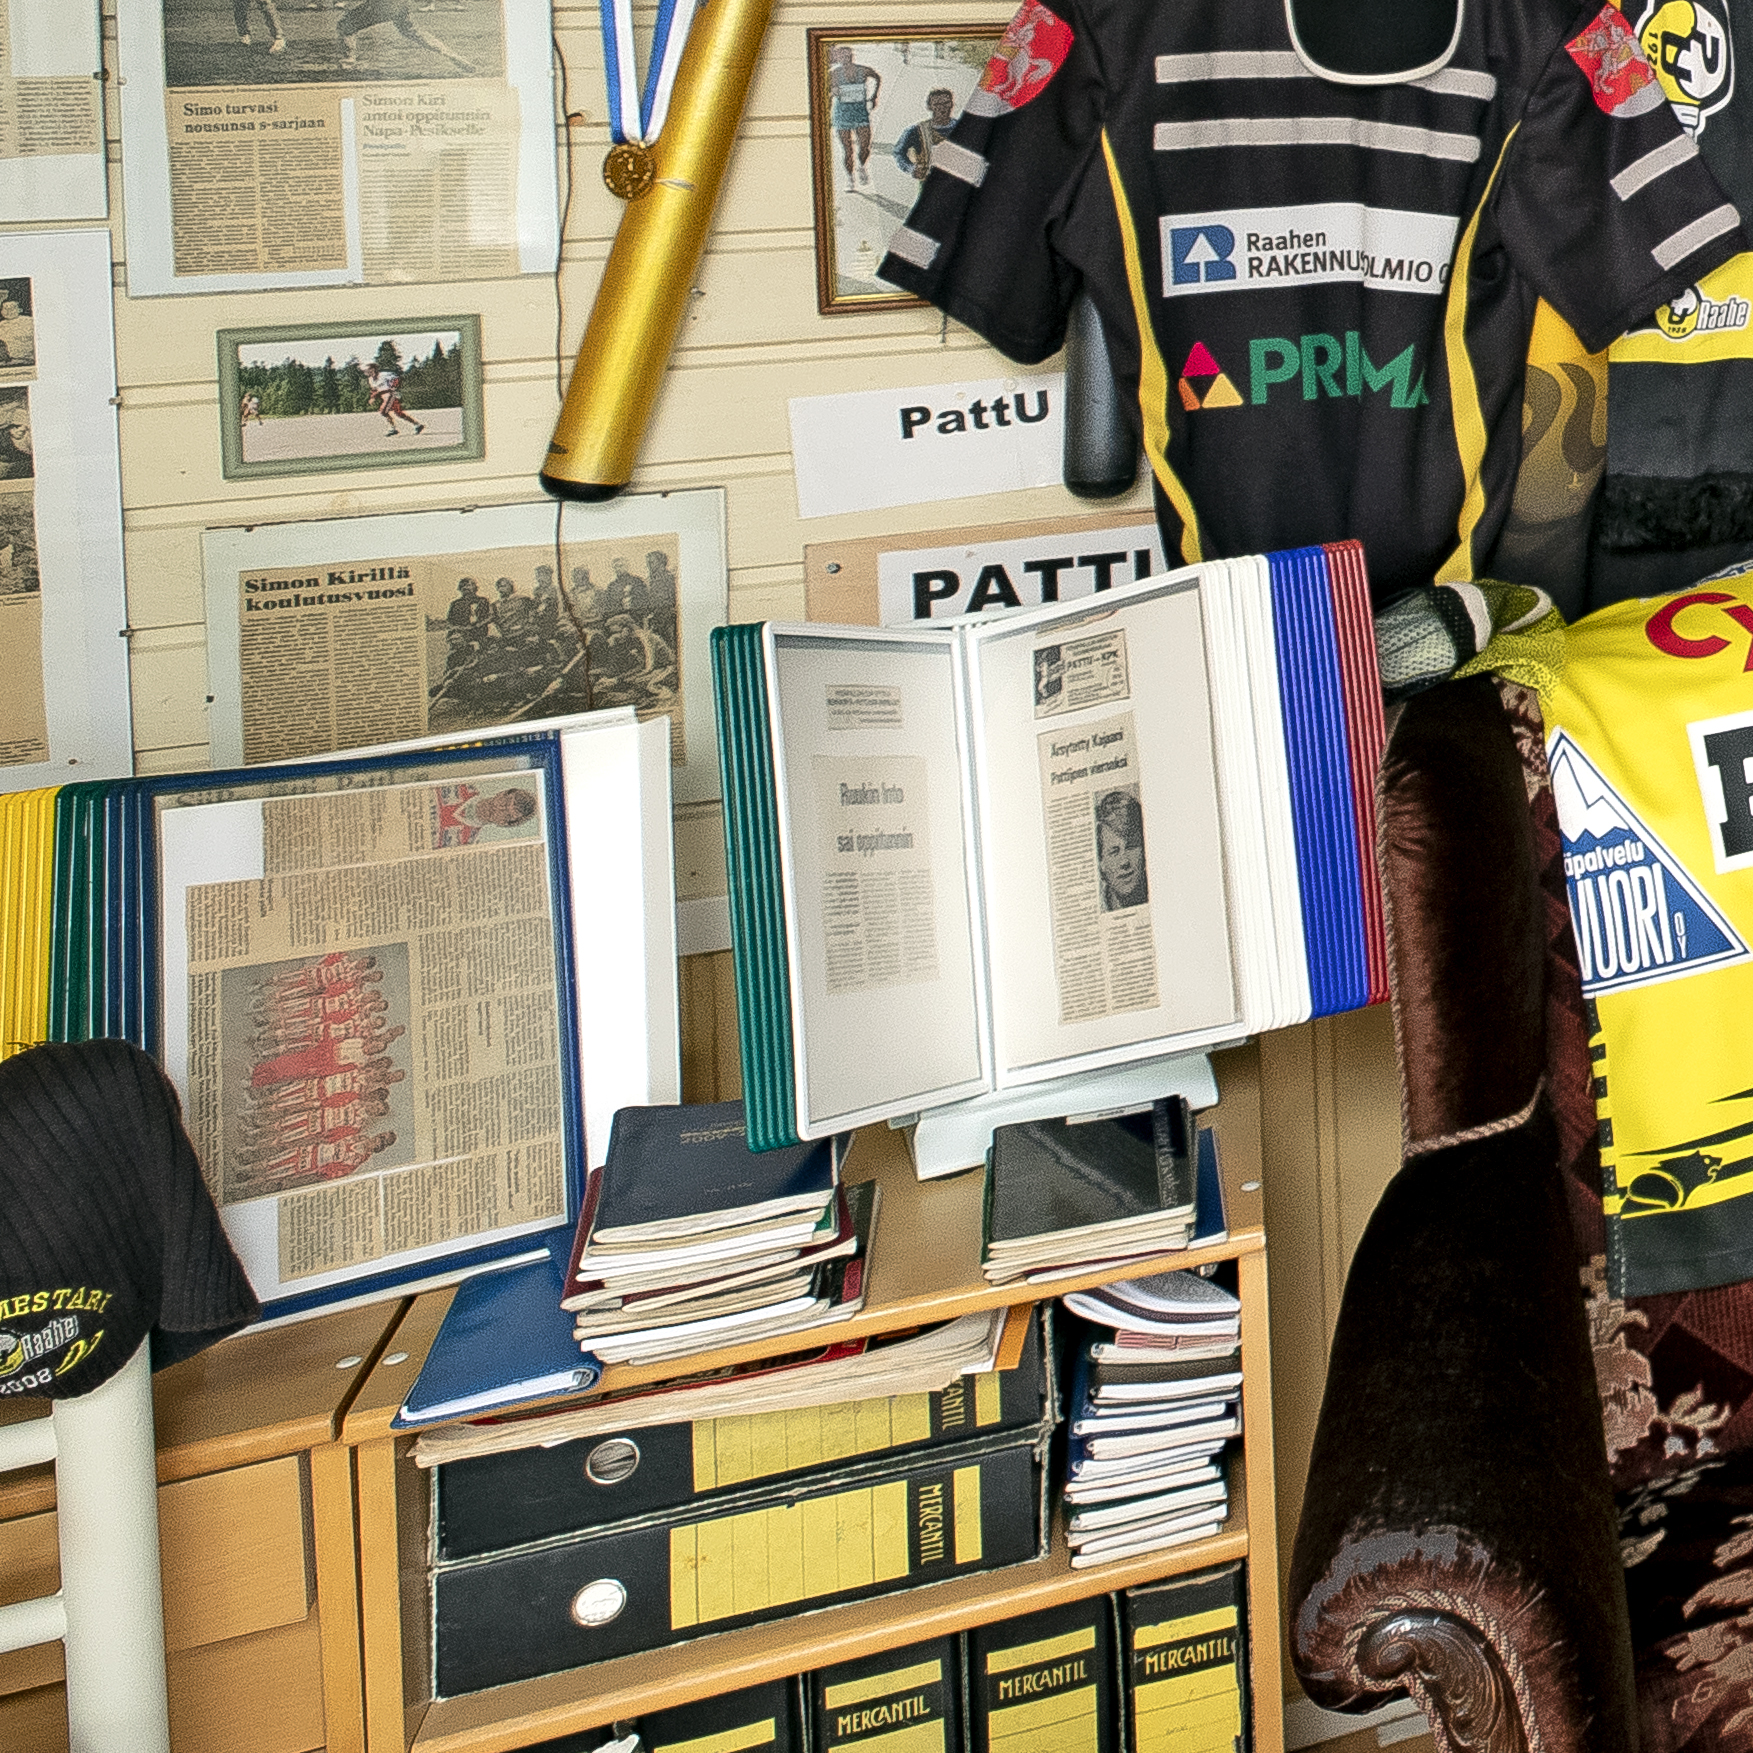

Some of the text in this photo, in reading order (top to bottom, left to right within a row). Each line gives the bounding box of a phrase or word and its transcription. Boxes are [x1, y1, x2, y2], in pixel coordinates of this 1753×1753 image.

[183, 101, 278, 117] Simo turvasi
[184, 118, 325, 134] nousunsa s-sarjaan
[1247, 230, 1326, 252] Raahen
[1699, 300, 1748, 329] Raahe
[900, 389, 1050, 439] PattU
[245, 565, 411, 594] Simon Kirillä
[246, 584, 414, 612] koulutusvuosi
[21, 1314, 80, 1362] Raahe
[918, 1482, 945, 1566] MERCANTIL
[1145, 1637, 1236, 1675] MERCANTIL
[998, 1658, 1088, 1701] MERCANTIL
[837, 1693, 931, 1736] MERCANTIL
